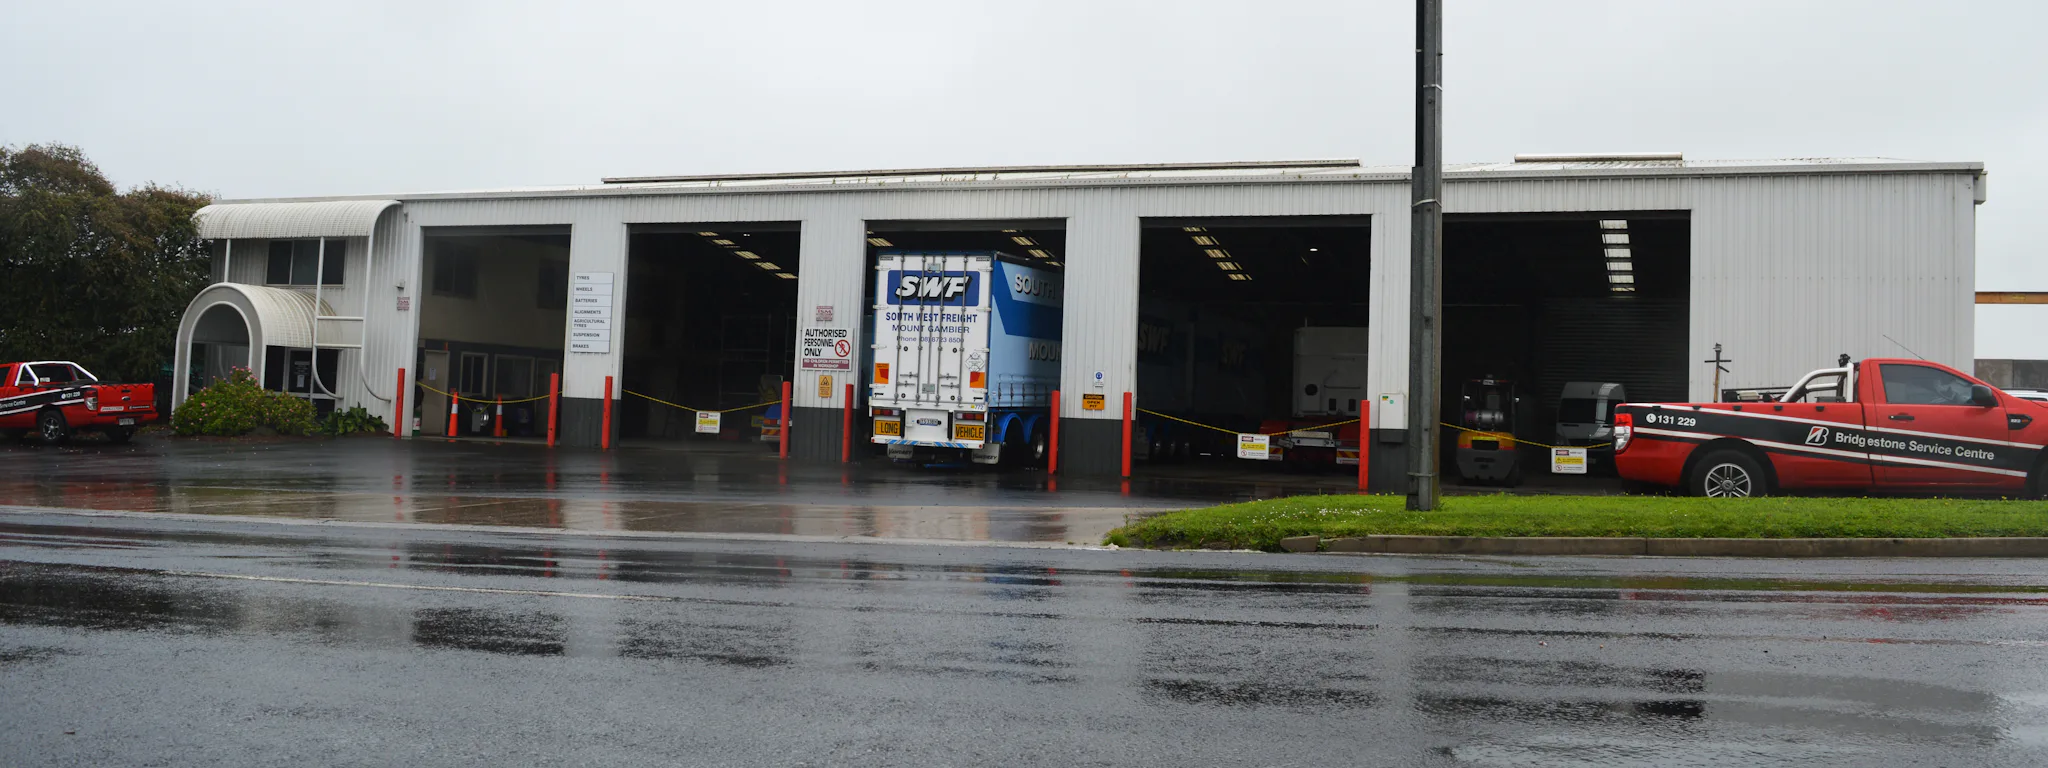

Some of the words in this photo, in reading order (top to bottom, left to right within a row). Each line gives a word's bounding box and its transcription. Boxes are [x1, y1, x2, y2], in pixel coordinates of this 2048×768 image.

[895, 275, 971, 300] SWF
[1015, 273, 1056, 299] SOUTH
[885, 311, 914, 321] SOUTH
[941, 313, 978, 323] FREIGHT
[805, 328, 847, 338] AUTHORISED
[891, 324, 925, 333] MOUNT
[927, 325, 970, 334] GAMBIER
[803, 338, 835, 347] PERSONNEL
[803, 347, 823, 357] ONLY
[1657, 414, 1675, 425] 131
[1677, 416, 1697, 427] 229
[880, 422, 899, 434] LONG
[955, 426, 984, 439] VEHICLE
[1835, 431, 1906, 450] Bridgestone
[1908, 440, 1953, 455] Service
[1954, 446, 1995, 460] Centre
